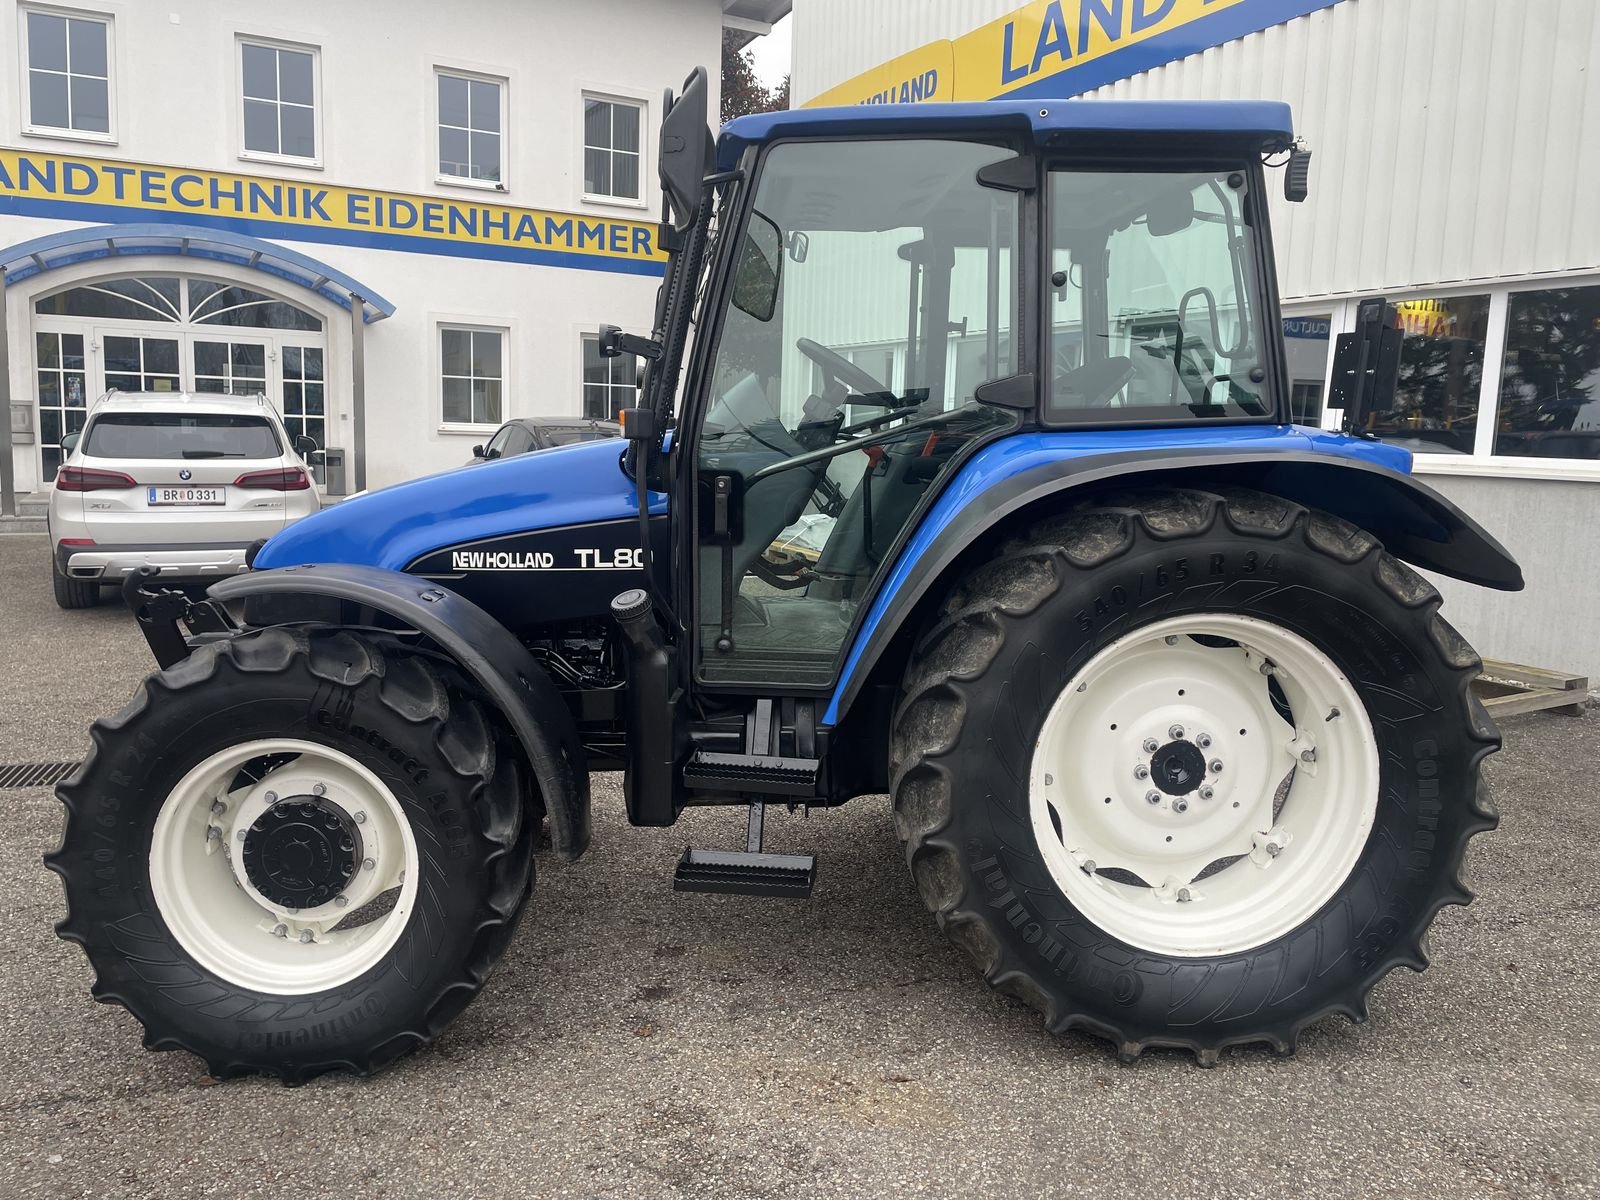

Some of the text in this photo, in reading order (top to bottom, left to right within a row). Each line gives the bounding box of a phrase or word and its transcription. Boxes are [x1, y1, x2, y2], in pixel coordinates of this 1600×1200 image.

[1001, 0, 1216, 86] LAND
[860, 69, 938, 105] LLAND
[347, 193, 653, 256] EIDENHAMMER
[163, 490, 178, 500] BR
[453, 551, 554, 567] NEW HOLLAND
[574, 548, 644, 567] TL80
[1208, 551, 1225, 575] R
